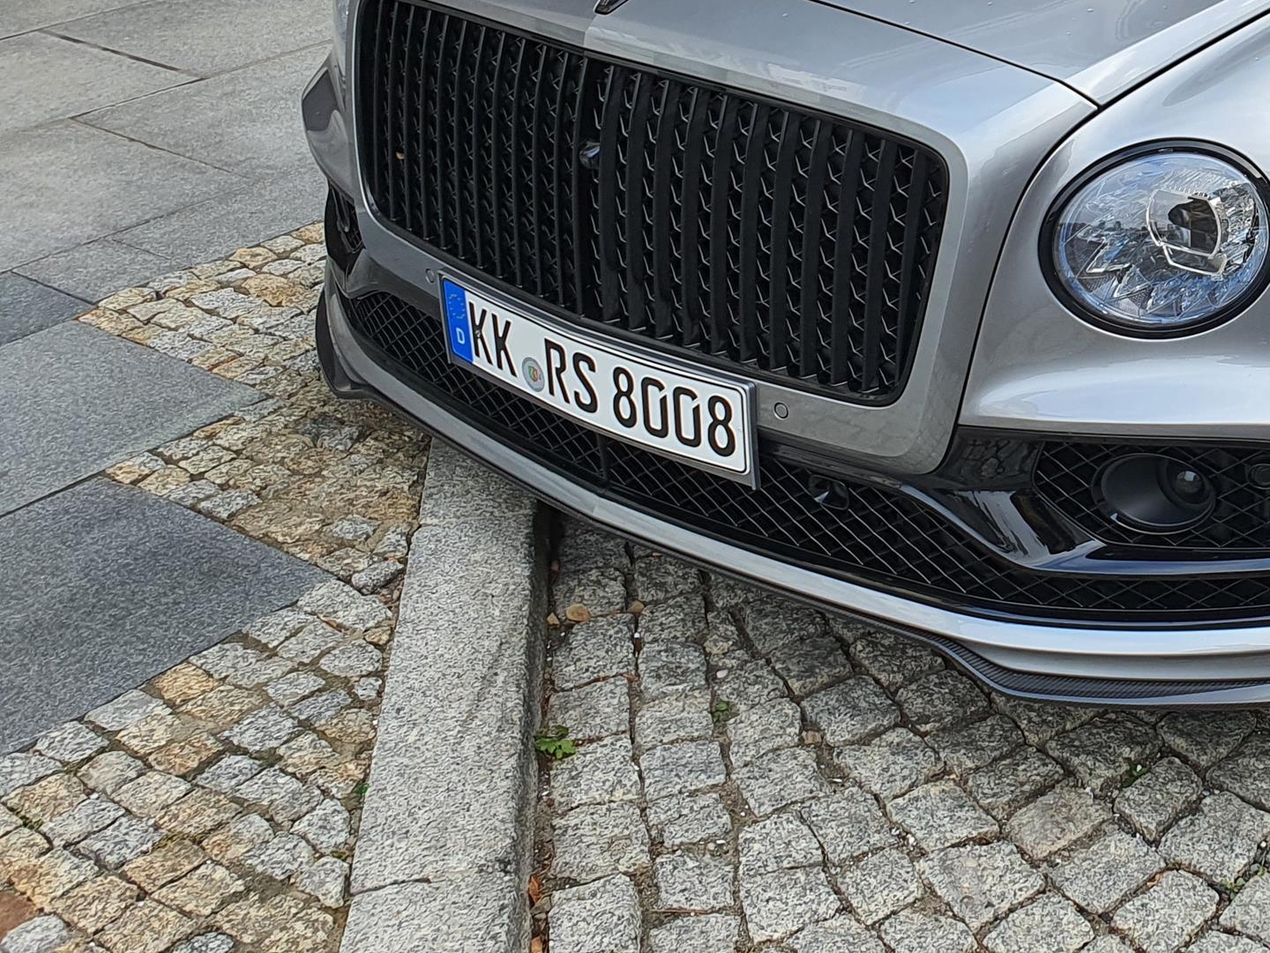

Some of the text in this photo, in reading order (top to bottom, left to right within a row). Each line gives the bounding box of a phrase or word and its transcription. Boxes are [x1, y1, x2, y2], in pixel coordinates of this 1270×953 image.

[456, 327, 466, 345] D
[469, 301, 736, 458] KK RS 8008
